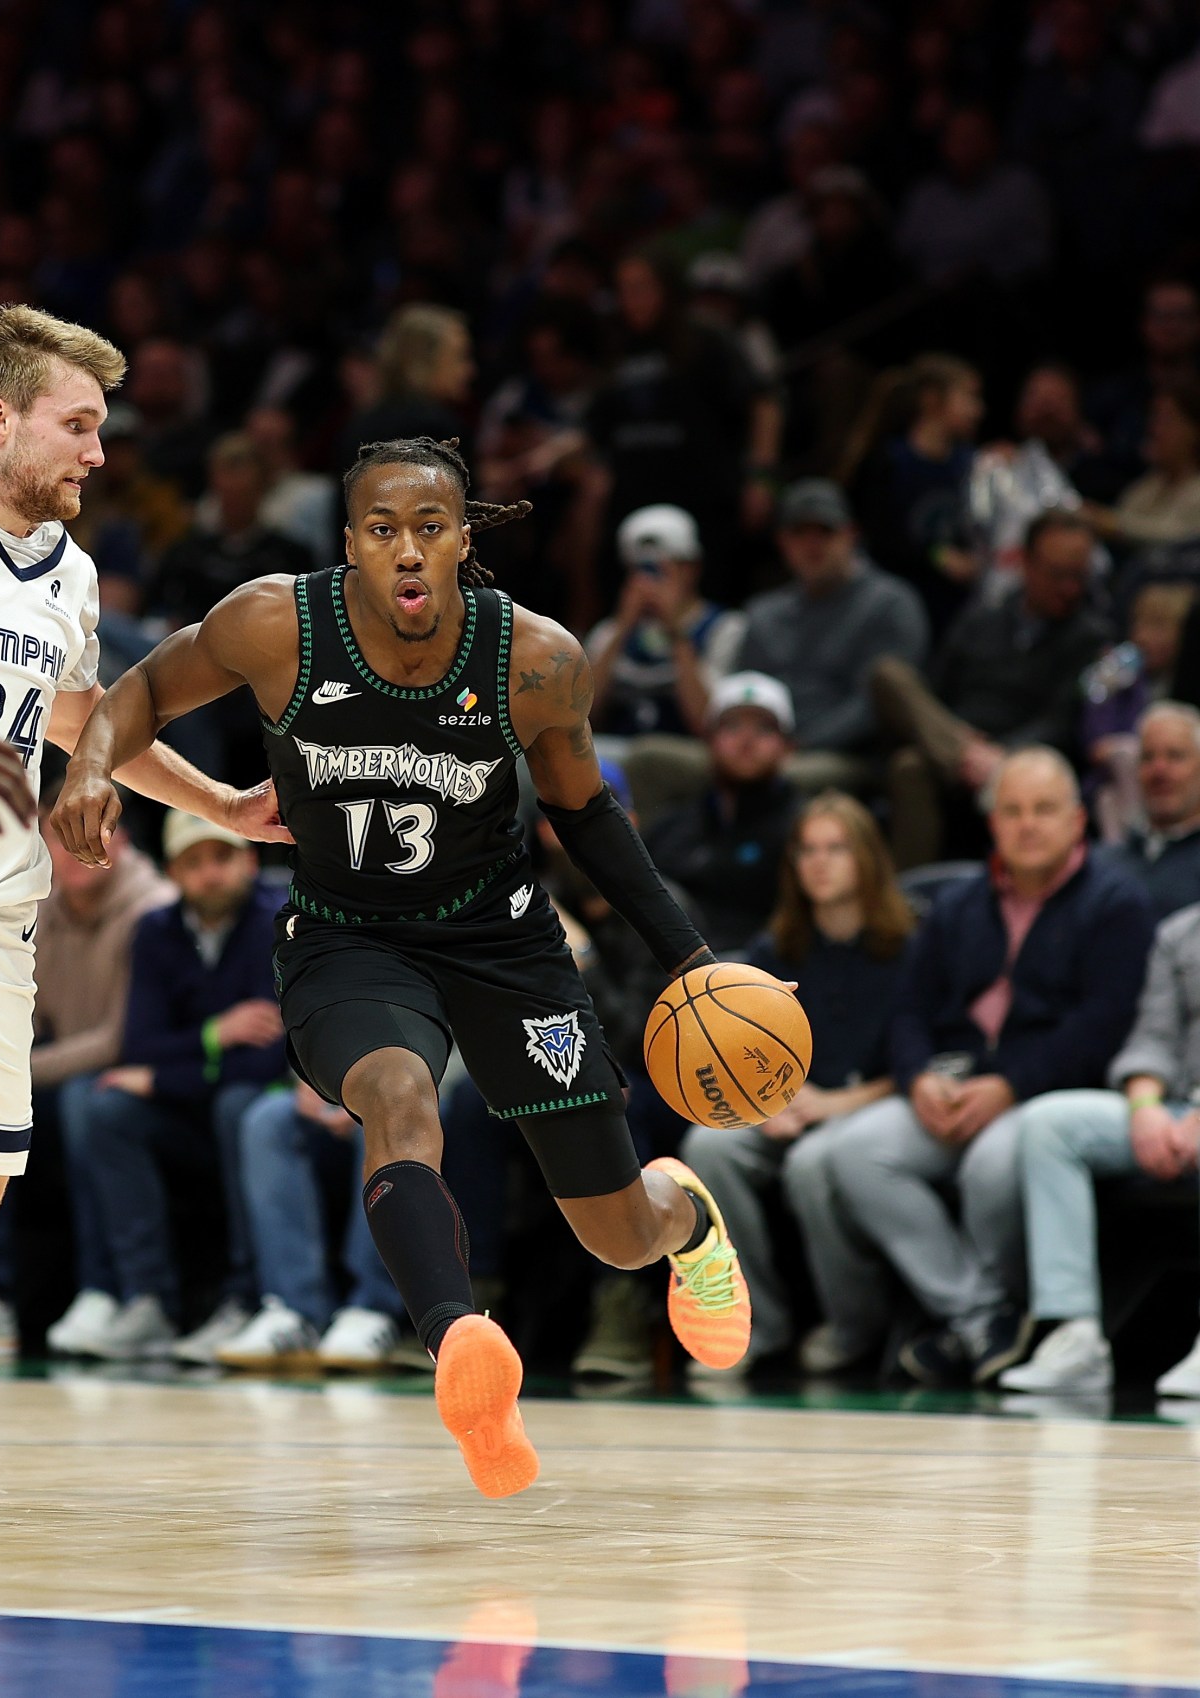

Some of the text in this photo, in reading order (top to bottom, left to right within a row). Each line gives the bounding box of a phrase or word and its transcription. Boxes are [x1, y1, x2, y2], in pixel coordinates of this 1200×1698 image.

[319, 680, 351, 697] NIKE
[438, 712, 492, 726] sezzle
[292, 735, 504, 806] TIMBERWOLVES
[335, 799, 437, 874] 13
[509, 884, 529, 911] NIKE
[695, 1063, 753, 1129] ilson
